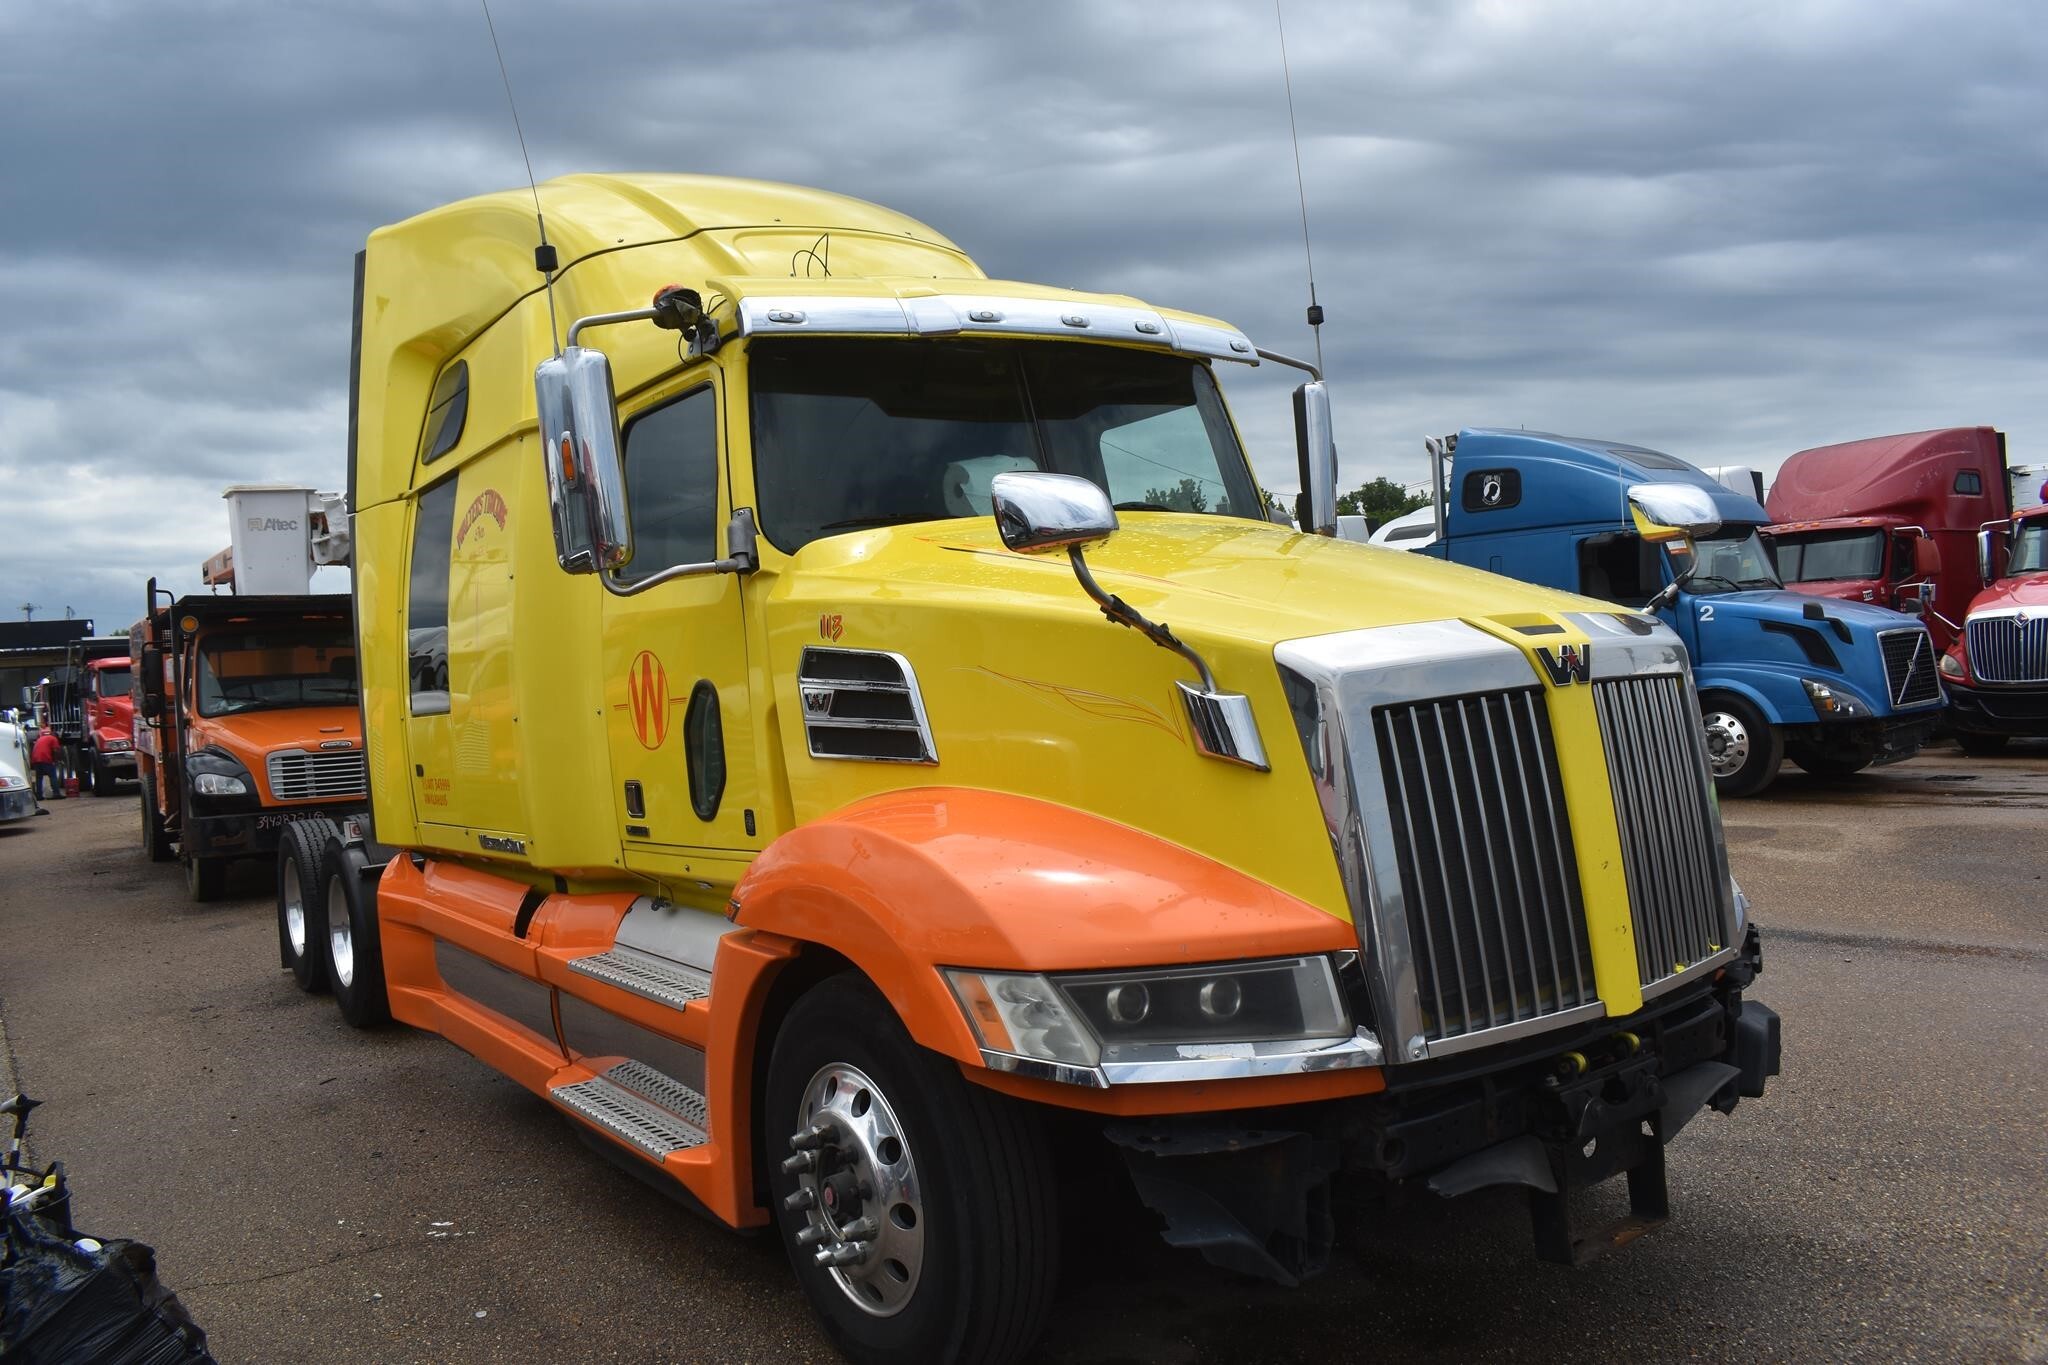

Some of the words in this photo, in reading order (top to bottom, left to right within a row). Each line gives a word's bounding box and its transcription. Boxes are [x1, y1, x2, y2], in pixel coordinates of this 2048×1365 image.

[263, 517, 298, 531] Altec
[1699, 605, 1715, 622] 2
[820, 614, 844, 643] 113
[629, 653, 665, 745] W
